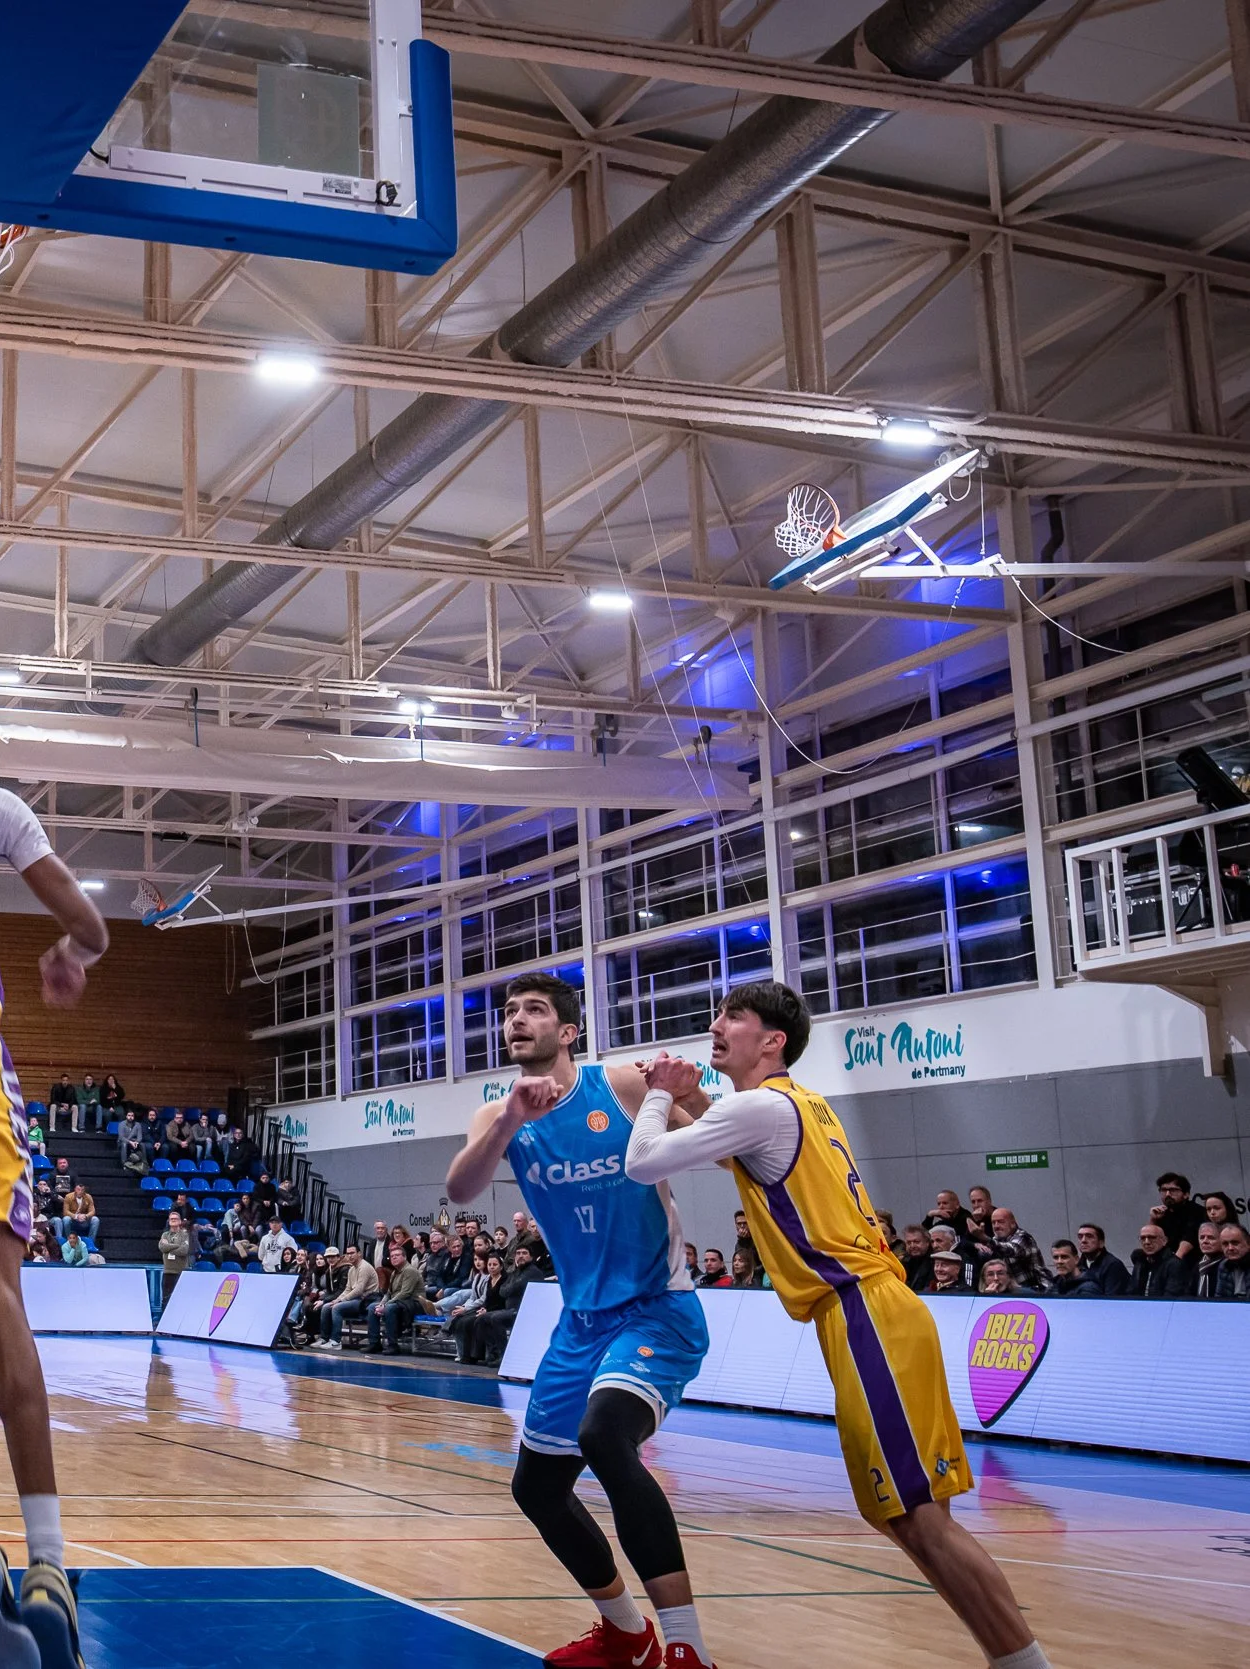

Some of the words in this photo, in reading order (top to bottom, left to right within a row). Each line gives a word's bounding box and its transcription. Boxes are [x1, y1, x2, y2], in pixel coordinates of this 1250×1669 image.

[844, 1028, 887, 1071] Sant
[891, 1021, 965, 1066] Antoni
[856, 1026, 875, 1038] Visit
[911, 1067, 922, 1080] de
[923, 1064, 966, 1078] Portmany
[364, 1100, 383, 1129] Sant
[385, 1098, 415, 1127] Antoni
[546, 1154, 621, 1186] Class
[828, 1136, 878, 1228] 2
[409, 1212, 435, 1227] Consell
[573, 1204, 597, 1234] 17
[982, 1313, 1038, 1341] IBIZA
[970, 1339, 1037, 1372] ROCKS
[869, 1467, 891, 1503] 2
